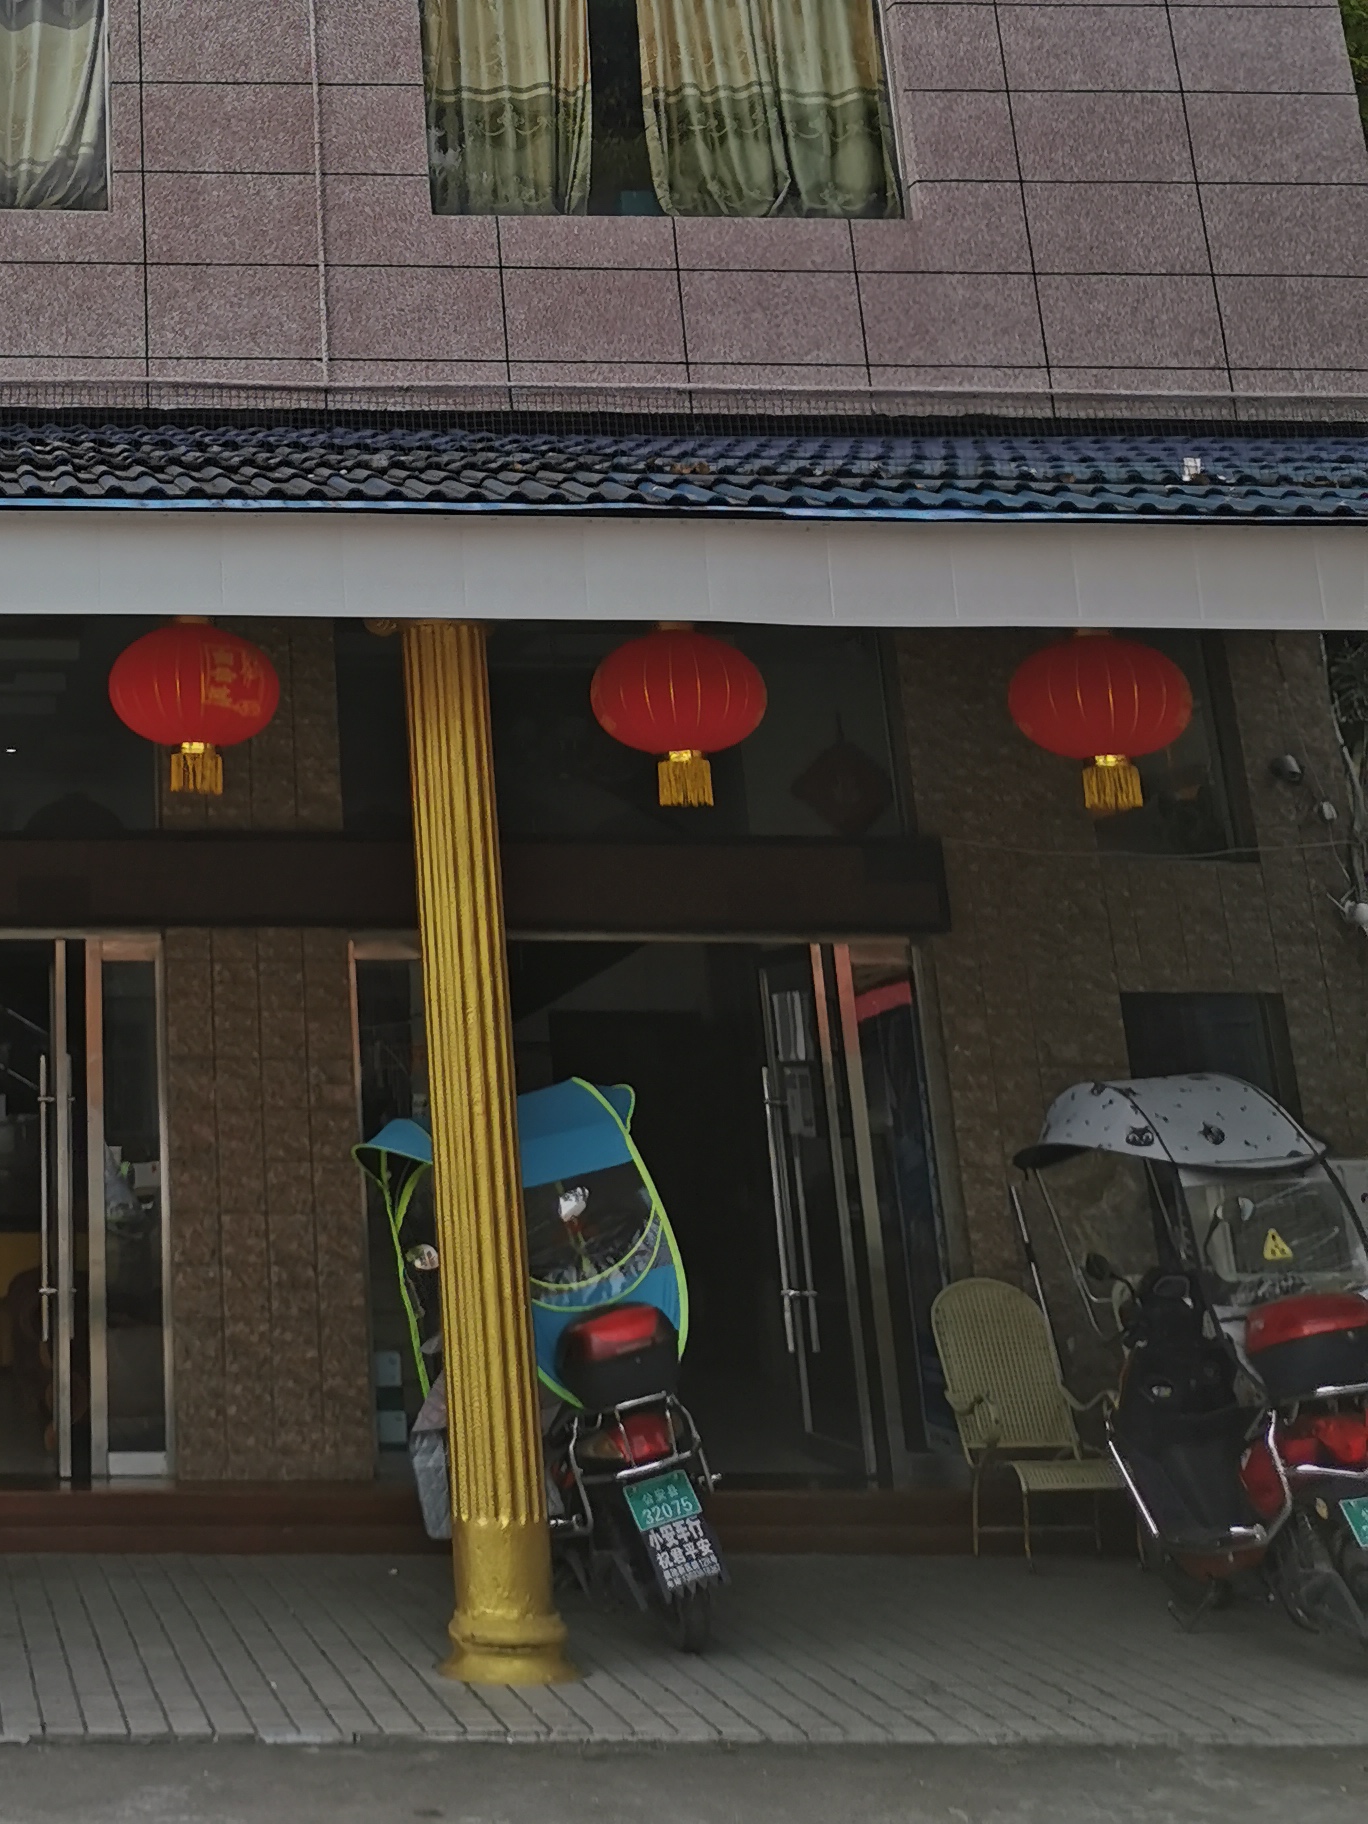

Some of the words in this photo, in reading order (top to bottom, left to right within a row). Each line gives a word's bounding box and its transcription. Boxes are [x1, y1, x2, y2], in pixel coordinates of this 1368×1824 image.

[642, 1496, 692, 1524] 32075
[648, 1517, 704, 1551] 小安车行
[657, 1538, 711, 1569] 祝君平安
